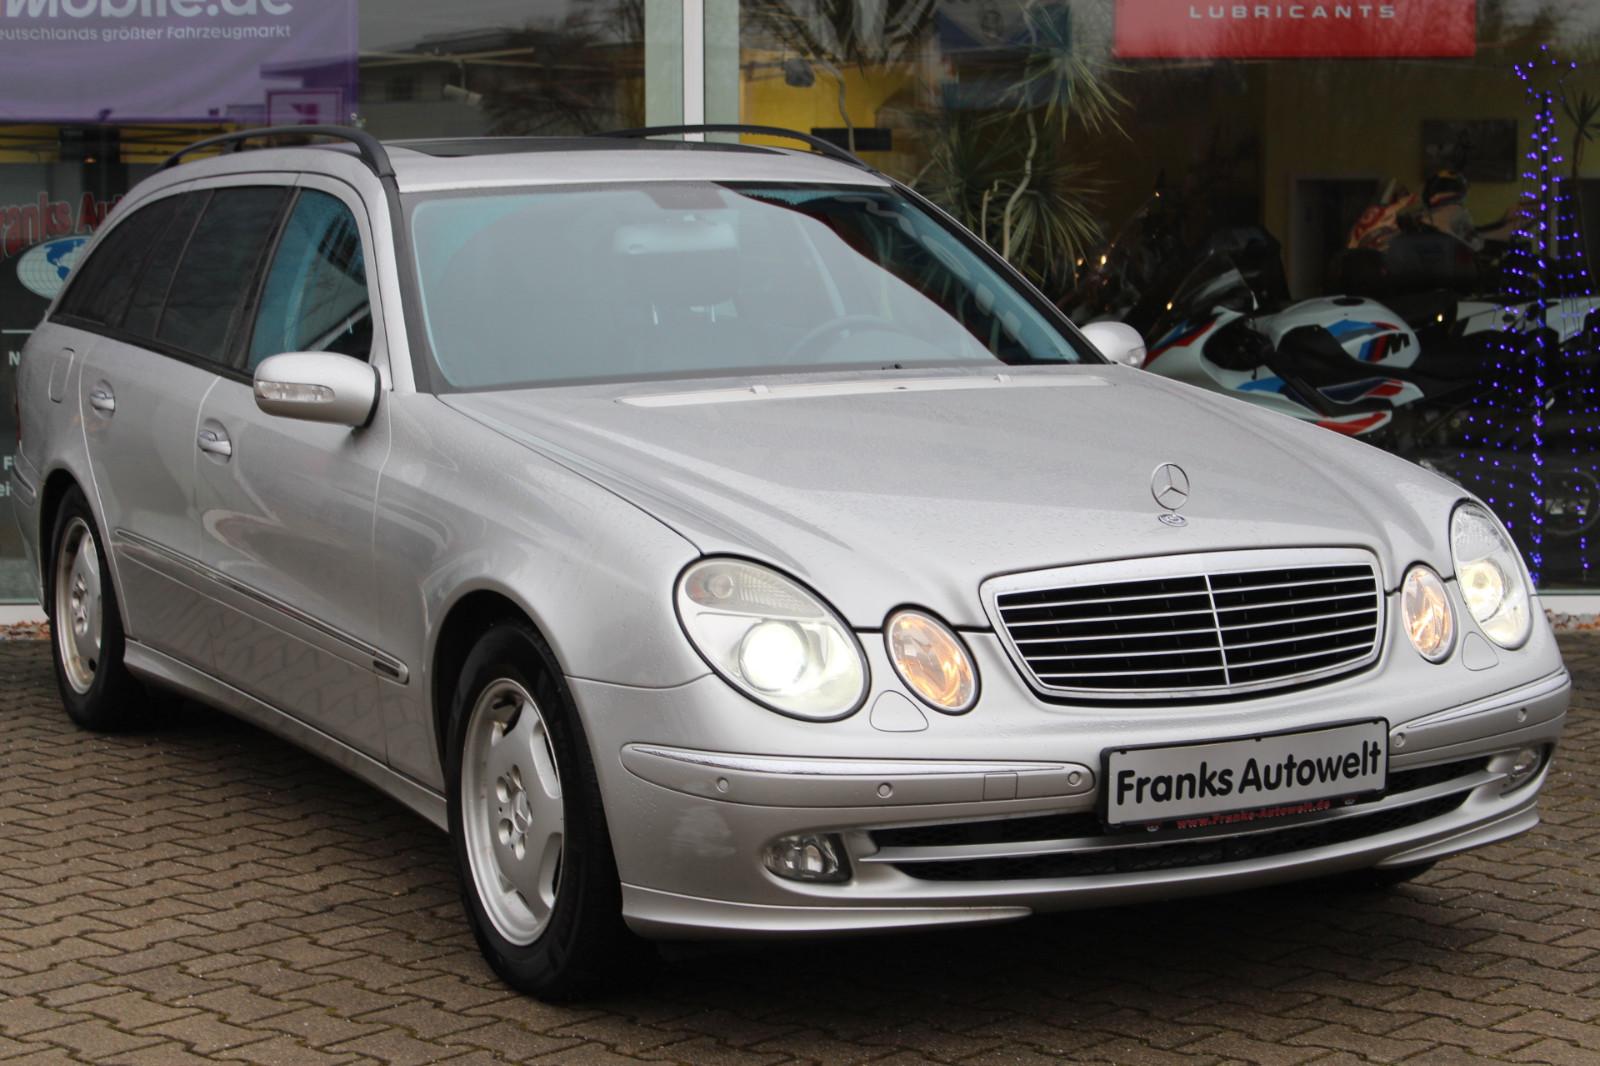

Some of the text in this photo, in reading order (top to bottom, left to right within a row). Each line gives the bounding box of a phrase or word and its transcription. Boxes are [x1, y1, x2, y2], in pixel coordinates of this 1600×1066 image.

[1189, 5, 1396, 19] LUBRICANTS
[102, 25, 163, 42] größter
[167, 25, 291, 40] Fahrzeugmarkt
[1116, 740, 1382, 805] Franks Autowelt
